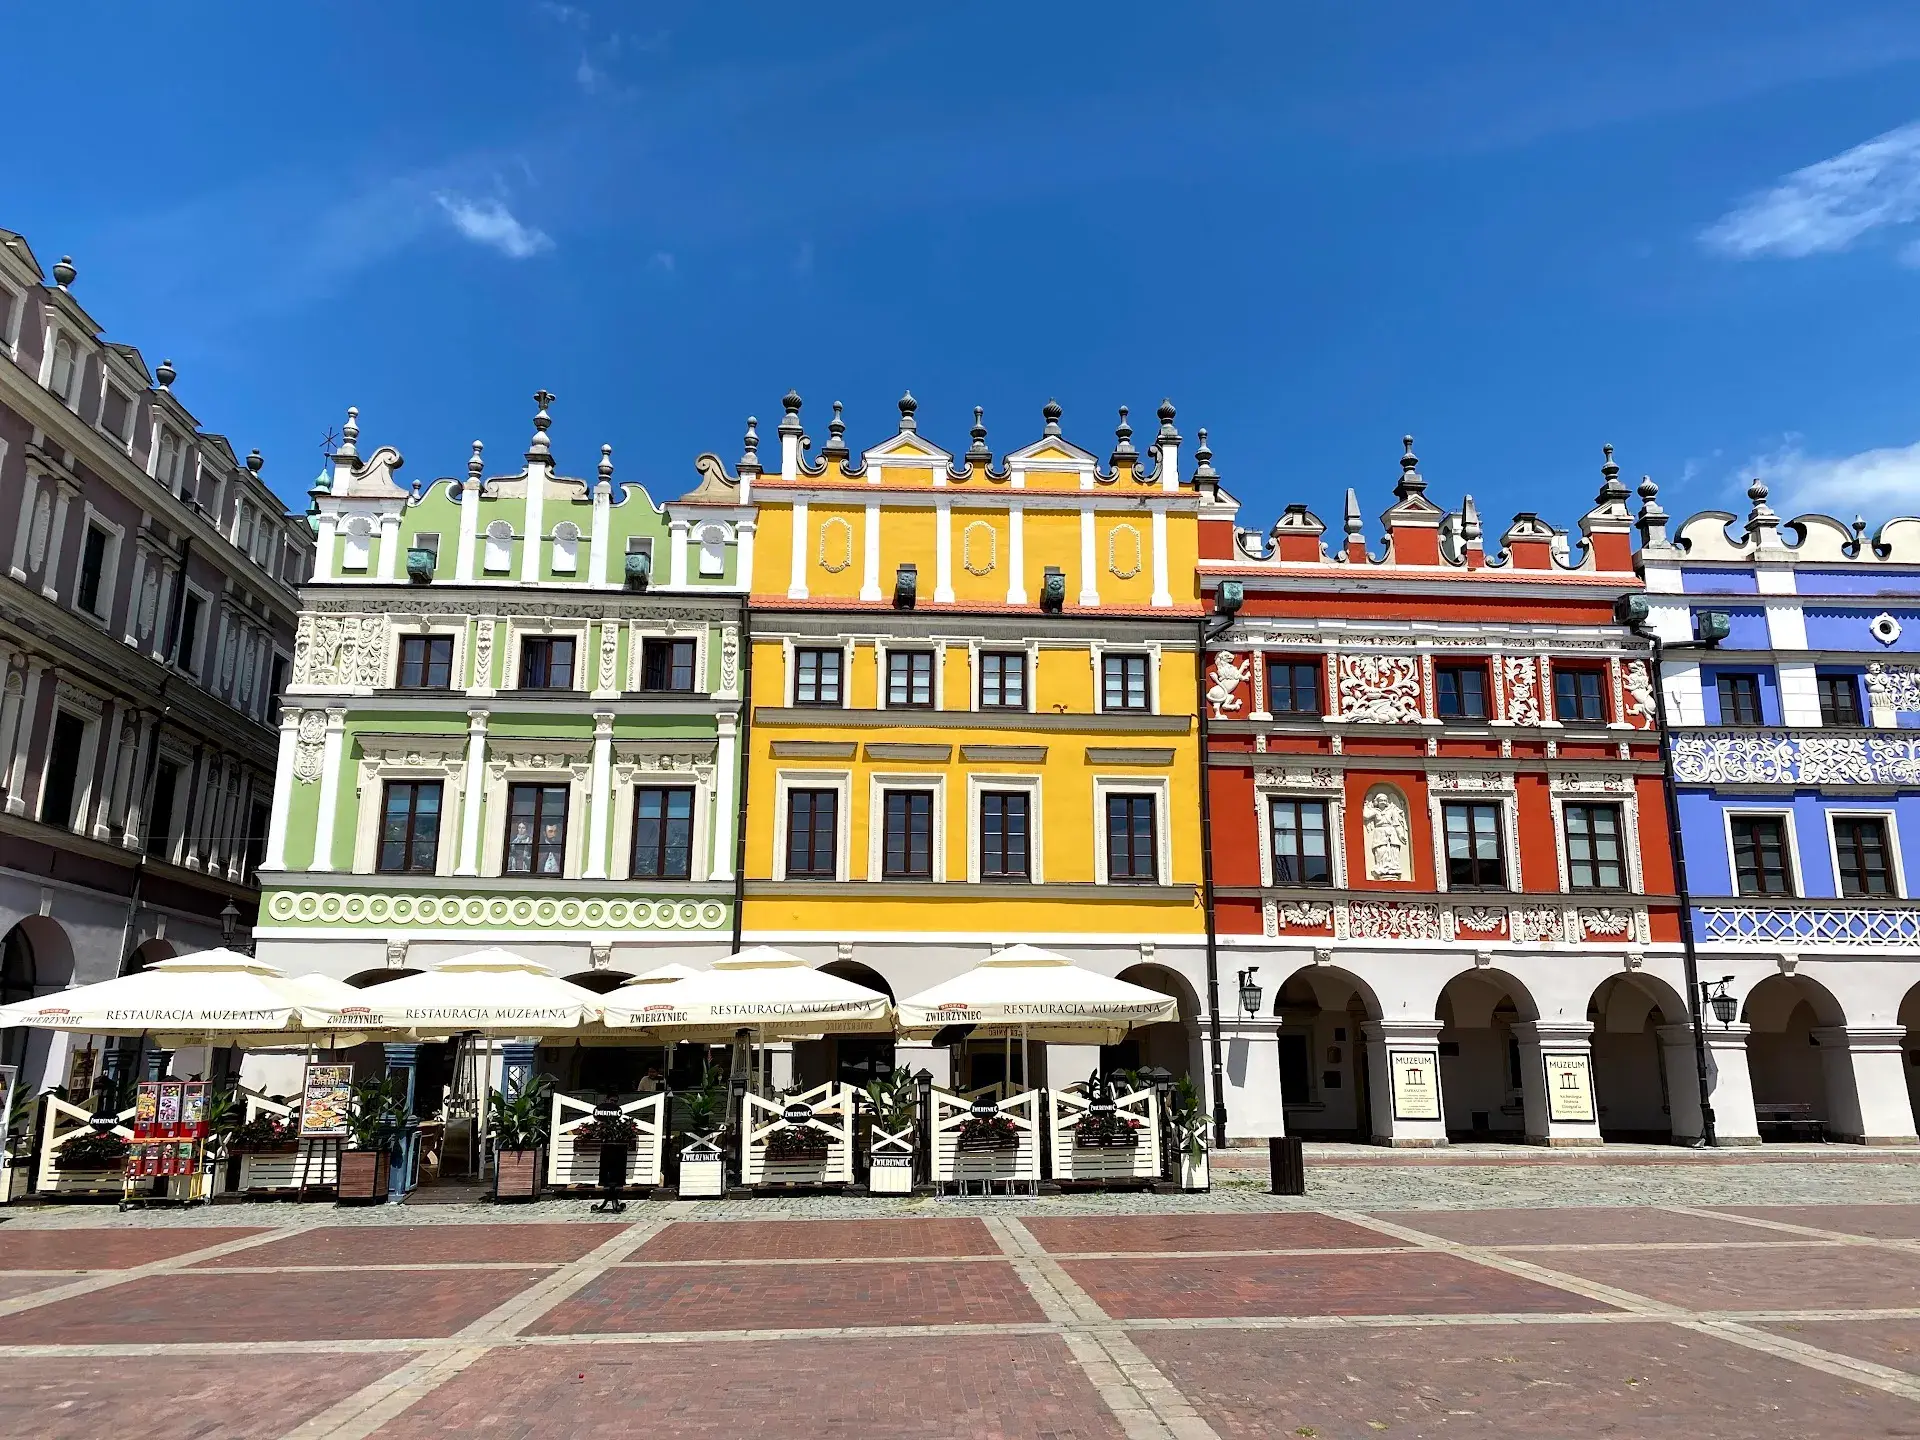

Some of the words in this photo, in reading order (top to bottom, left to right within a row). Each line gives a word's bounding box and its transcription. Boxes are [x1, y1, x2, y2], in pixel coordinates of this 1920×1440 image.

[710, 1004, 794, 1016] RESTAURACJA
[800, 1001, 872, 1013] MUZEALNA
[1003, 1004, 1086, 1015] RESTAURACJA
[1092, 1003, 1161, 1013] MUZEALNA
[106, 1009, 194, 1022] RESTAURACJA
[200, 1010, 275, 1021] MUZEALNA
[327, 1014, 384, 1024] ZWIERZYNIEC
[405, 1008, 489, 1021] RESTAURACJA
[495, 1008, 567, 1019] MUZEALNA
[630, 1012, 688, 1023] ZWIERZYNIEC
[926, 1010, 982, 1022] ZWIERZYNIEC
[20, 1015, 82, 1025] ZWIERZYNIEC
[1395, 1056, 1432, 1065] MUZEUM
[1549, 1061, 1585, 1069] MUZEUM
[681, 1152, 720, 1162] ZWIERZYNIEC
[872, 1157, 911, 1167] ZWIERZYNIEC
